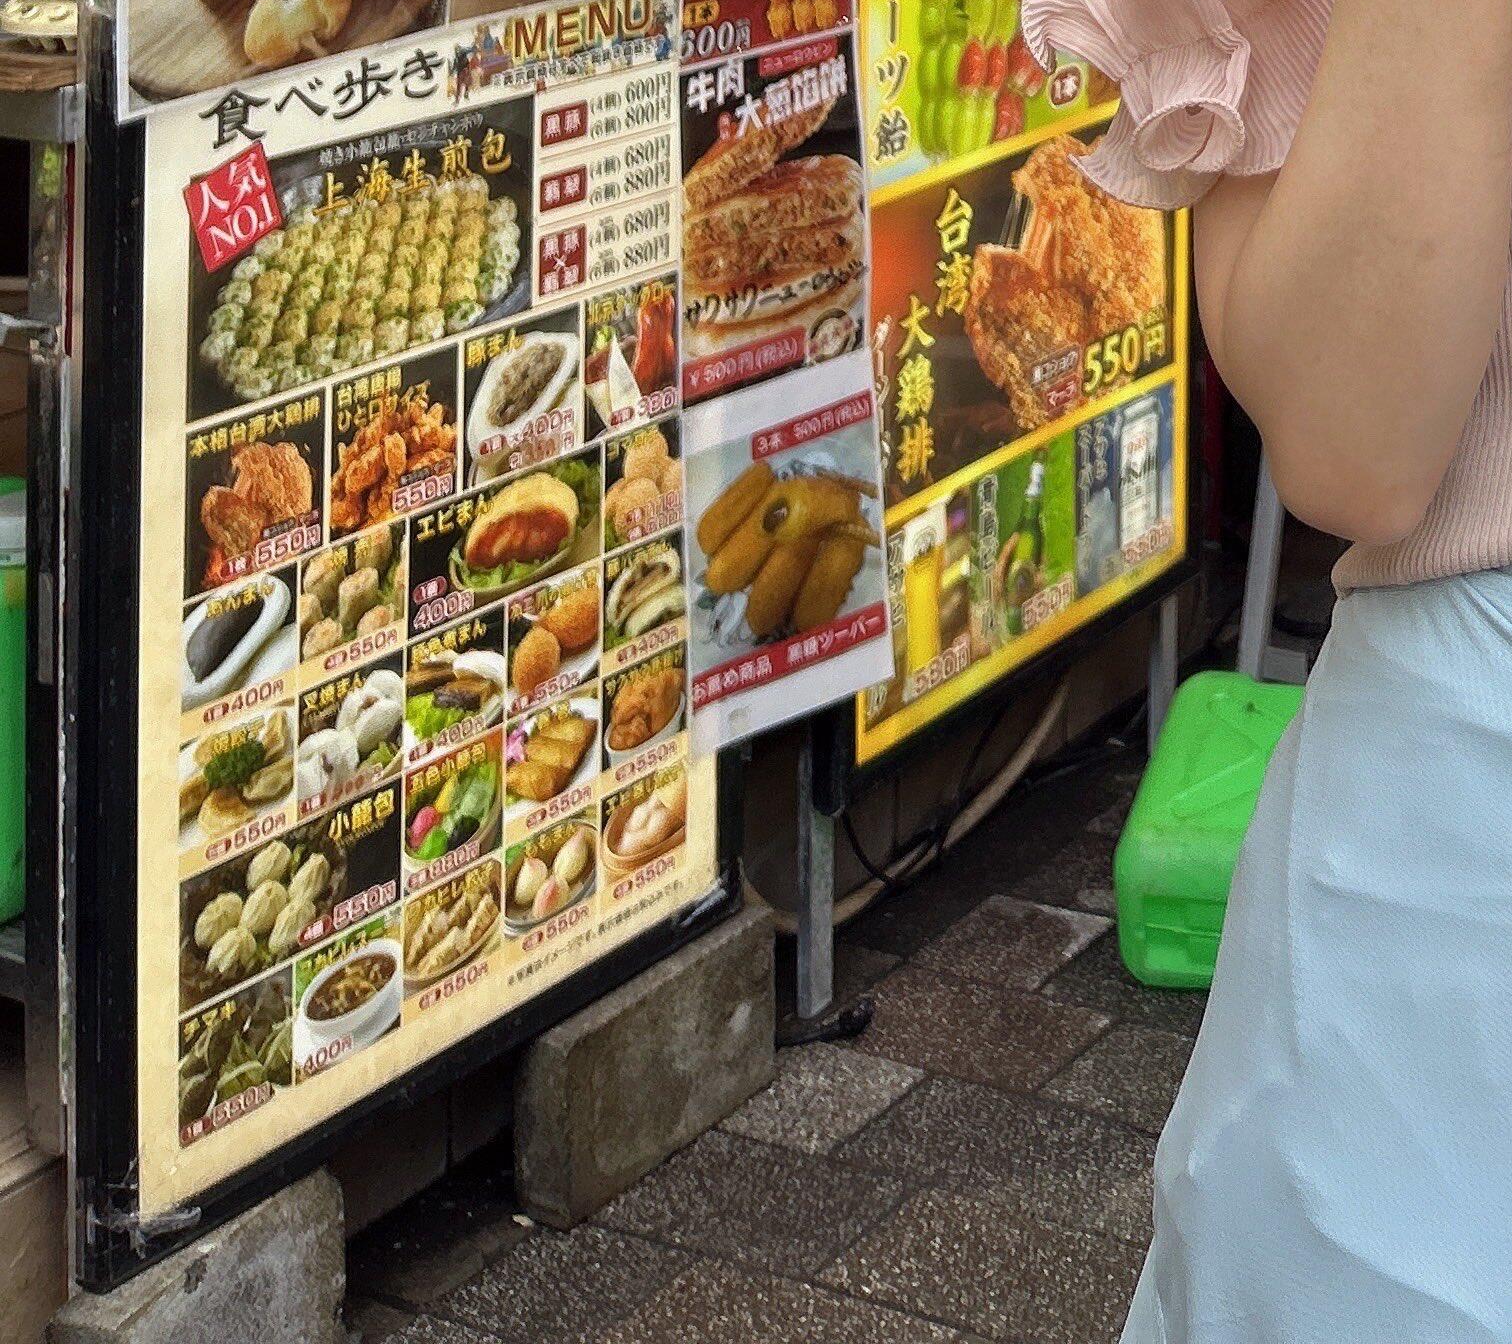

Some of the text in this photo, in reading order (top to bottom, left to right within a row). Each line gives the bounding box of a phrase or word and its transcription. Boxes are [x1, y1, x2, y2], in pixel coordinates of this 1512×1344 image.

[198, 47, 445, 150] 食べ歩き
[687, 62, 746, 113] 牛肉
[199, 151, 268, 227] 人気
[207, 193, 274, 260] NO.1
[1082, 324, 1167, 395] 550円
